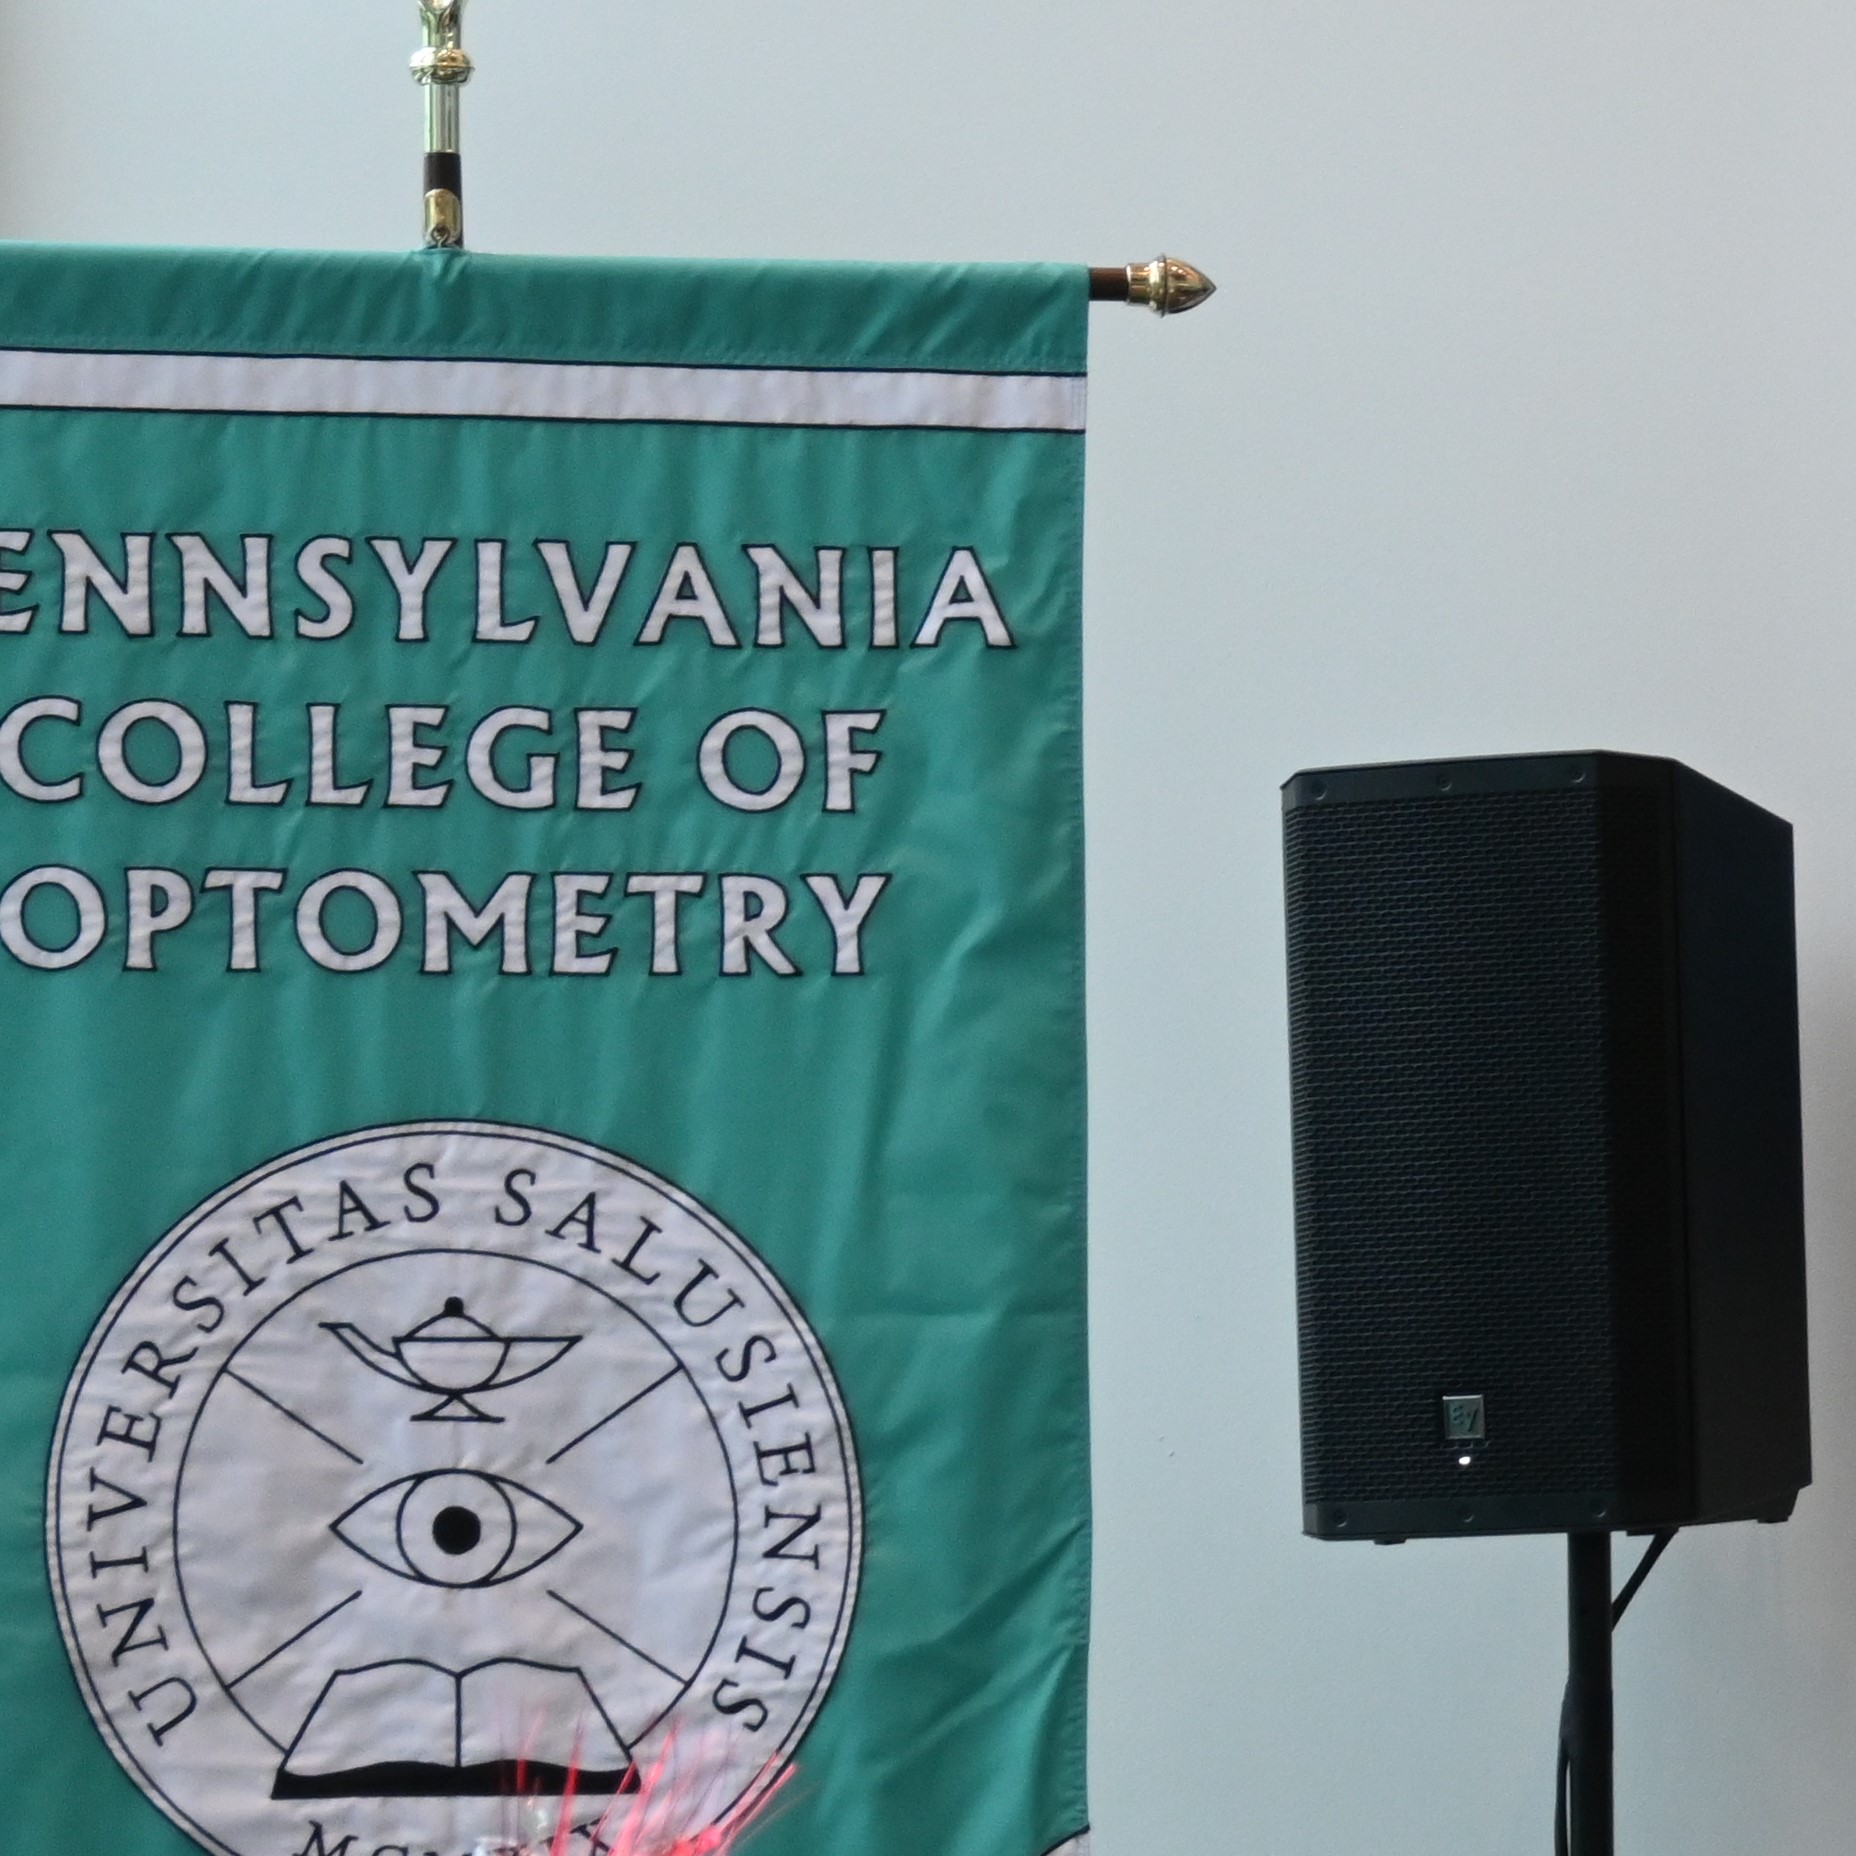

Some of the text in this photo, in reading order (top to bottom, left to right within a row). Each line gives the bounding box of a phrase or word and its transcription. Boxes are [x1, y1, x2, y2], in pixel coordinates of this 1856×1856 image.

[0, 528, 1018, 650] ENNSYLVANIA
[0, 695, 886, 813] COLLEGE OF
[0, 863, 889, 976] OPTOMETRY
[89, 1162, 822, 1745] UNIVERSITAS SALUSIENSIS
